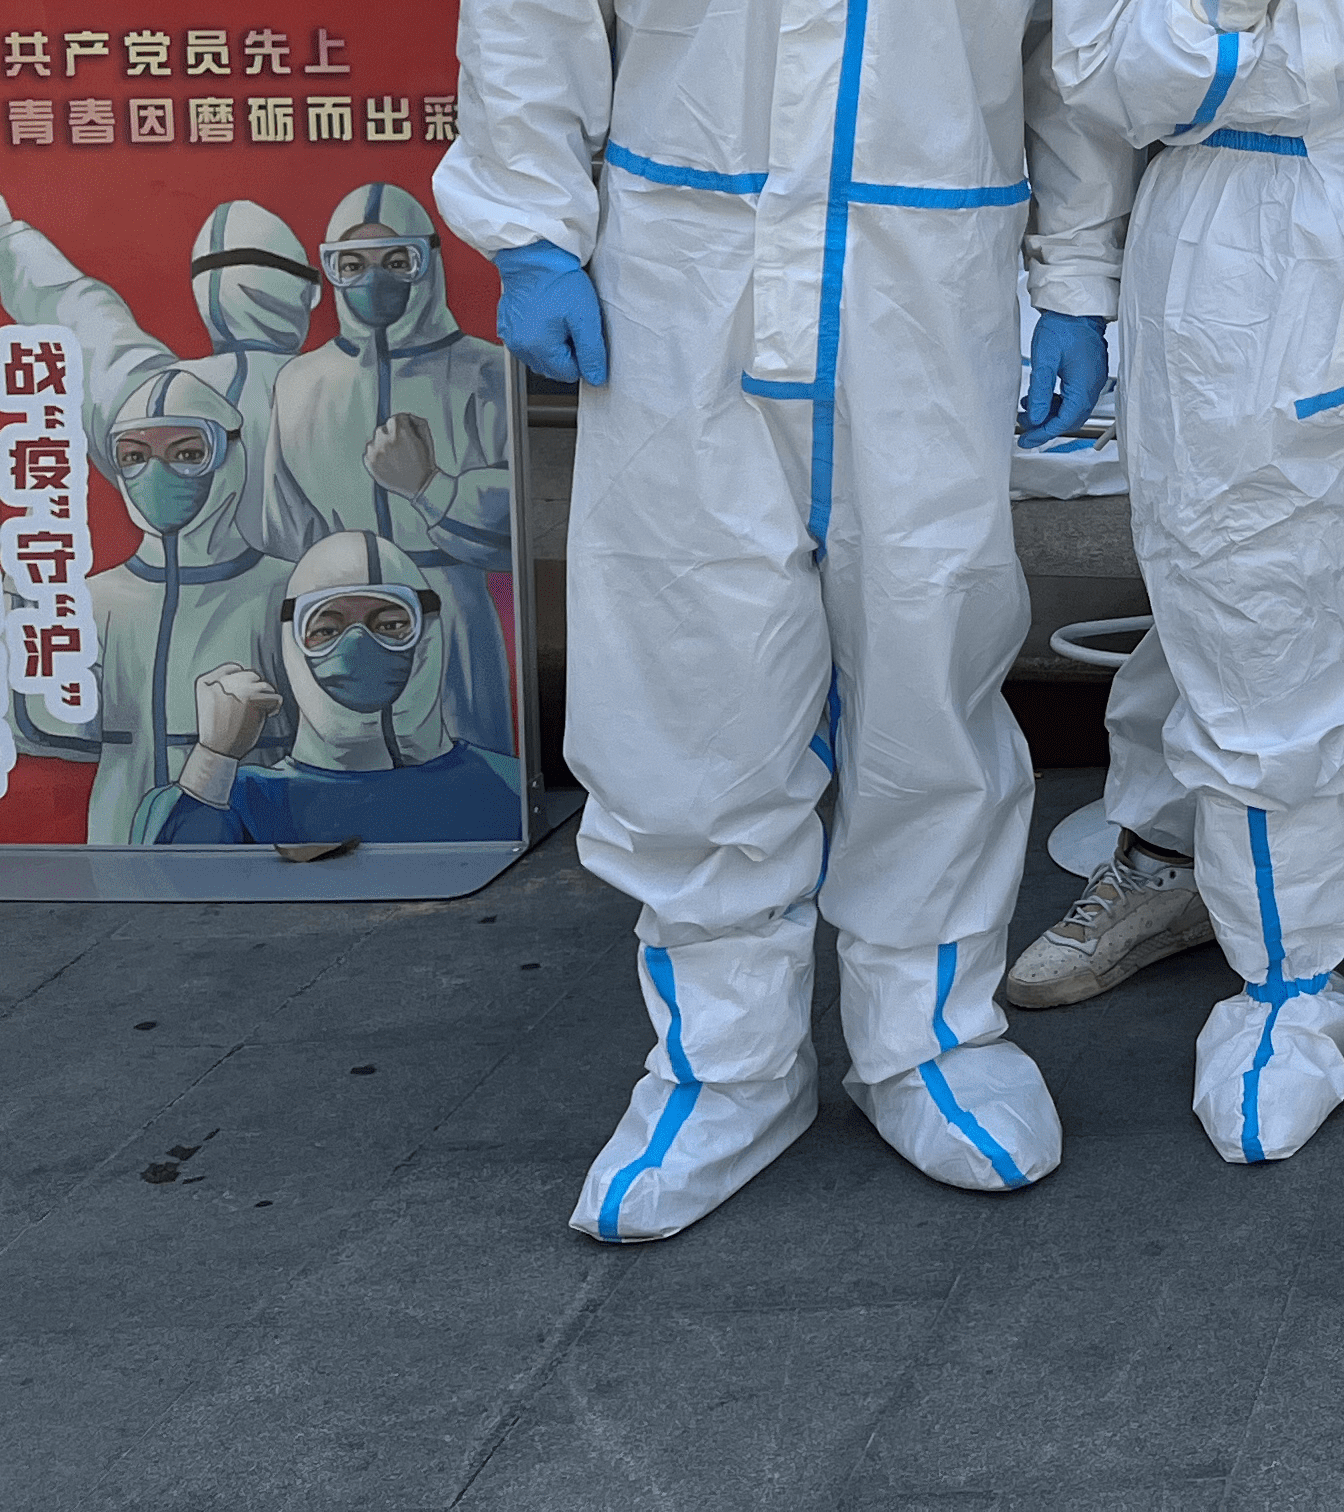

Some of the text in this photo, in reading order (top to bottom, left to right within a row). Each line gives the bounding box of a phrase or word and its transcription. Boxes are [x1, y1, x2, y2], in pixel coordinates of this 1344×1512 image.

[4, 28, 351, 78] 共产党员先上
[8, 94, 461, 146] 青春因磨砺而出彩
